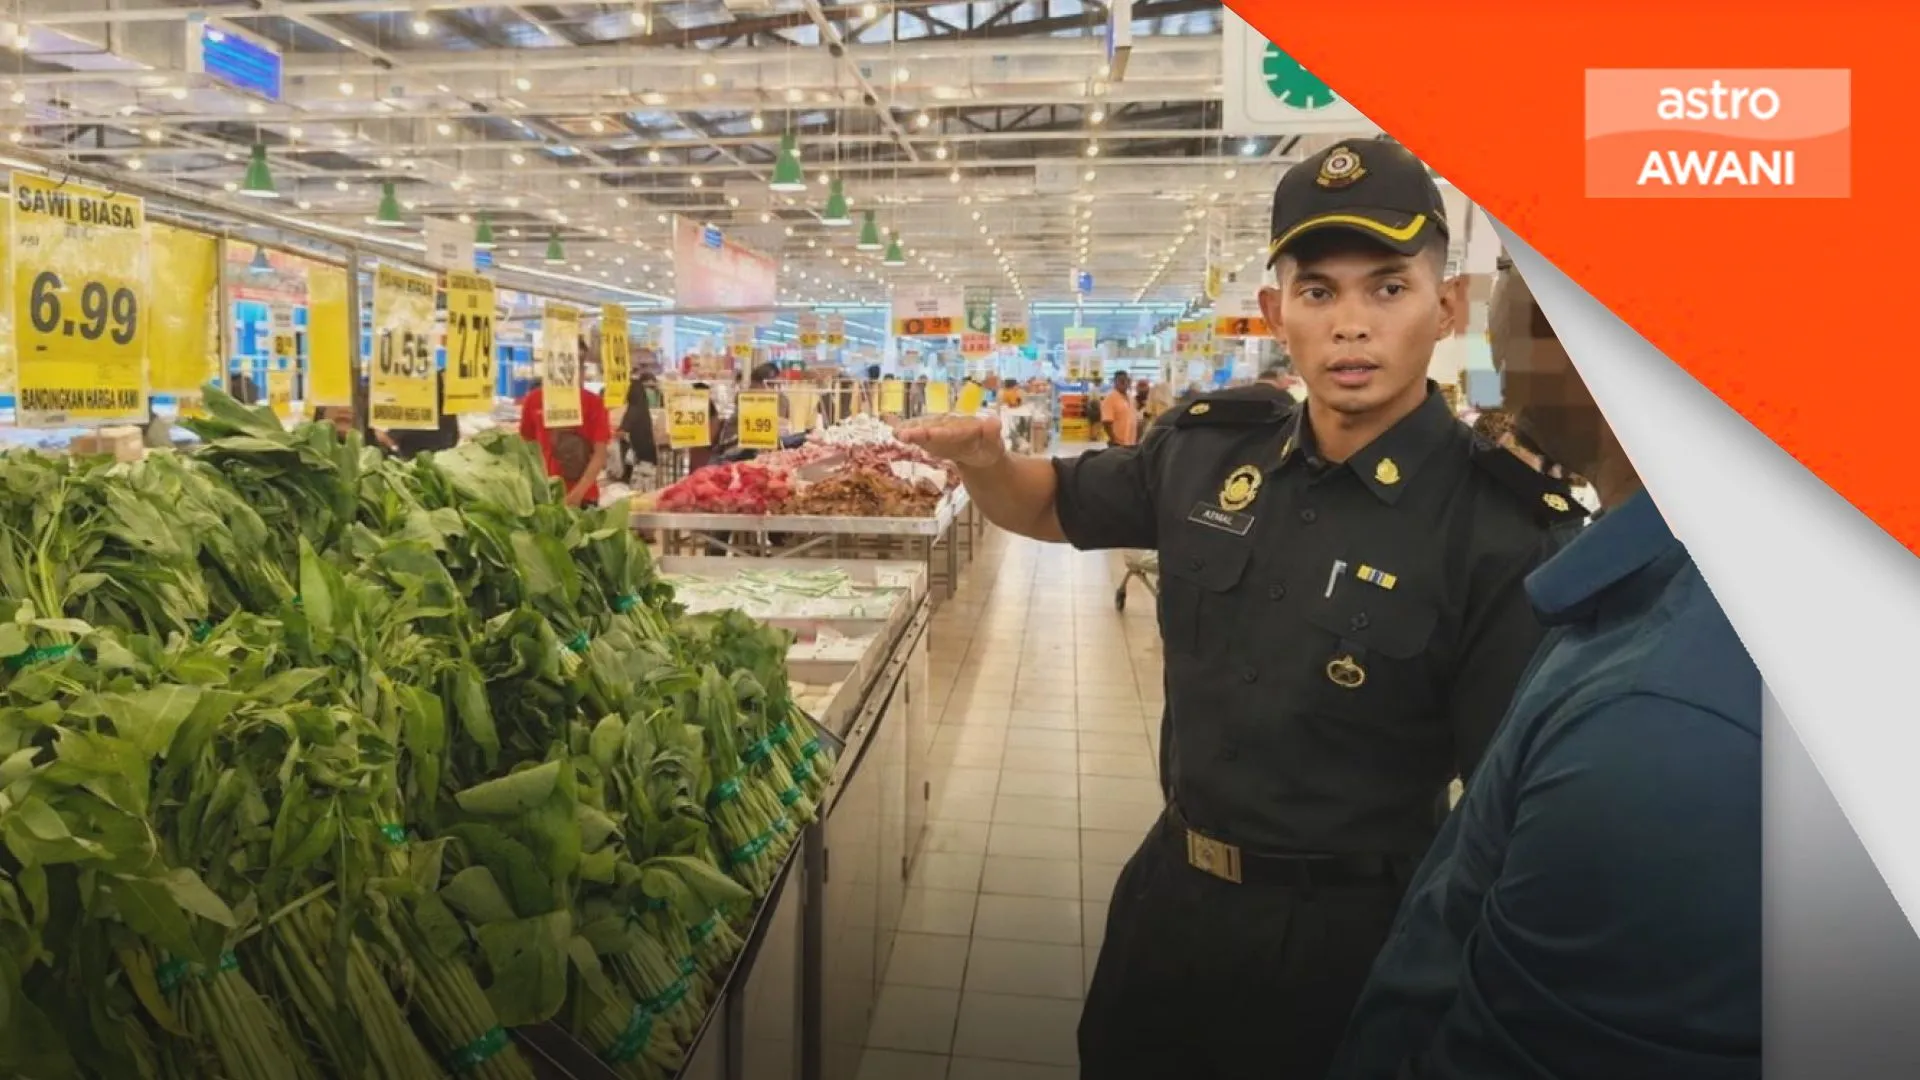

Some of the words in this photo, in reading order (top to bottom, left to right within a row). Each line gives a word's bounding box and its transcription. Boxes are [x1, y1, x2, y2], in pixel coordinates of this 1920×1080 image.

[18, 186, 71, 219] SAWI
[79, 197, 134, 228] BIASA
[31, 271, 137, 345] 6.99
[380, 328, 428, 377] 0.55
[457, 313, 491, 379] 2.79
[86, 388, 115, 410] HARGA
[118, 389, 139, 410] KAMI
[674, 411, 705, 426] 2.30
[744, 418, 771, 432] 1.99
